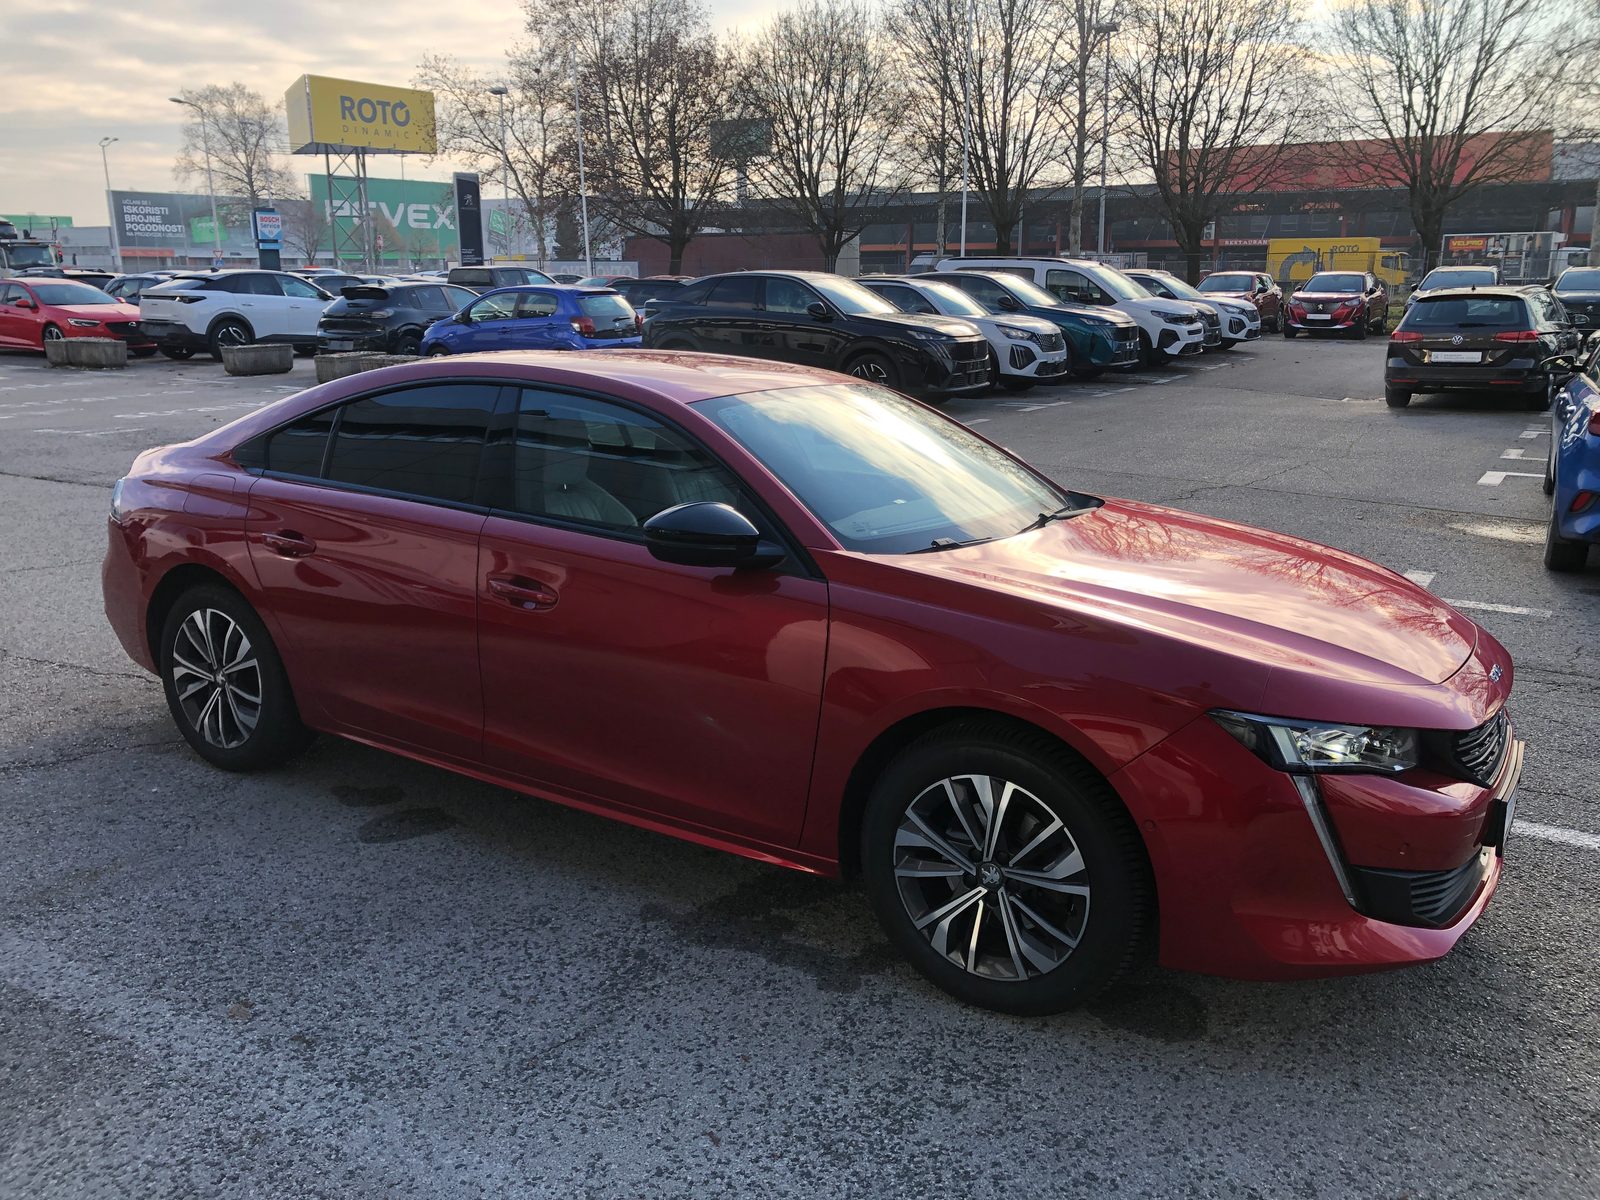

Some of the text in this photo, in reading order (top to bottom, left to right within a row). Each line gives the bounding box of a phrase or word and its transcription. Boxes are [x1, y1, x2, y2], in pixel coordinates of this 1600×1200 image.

[340, 95, 411, 127] ROTO
[342, 125, 409, 140] DINAMIC
[123, 205, 169, 215] ISKORISTI
[124, 214, 162, 223] BROJNE
[125, 223, 185, 233] POGODNOSTI
[1332, 244, 1360, 253] ROTO
